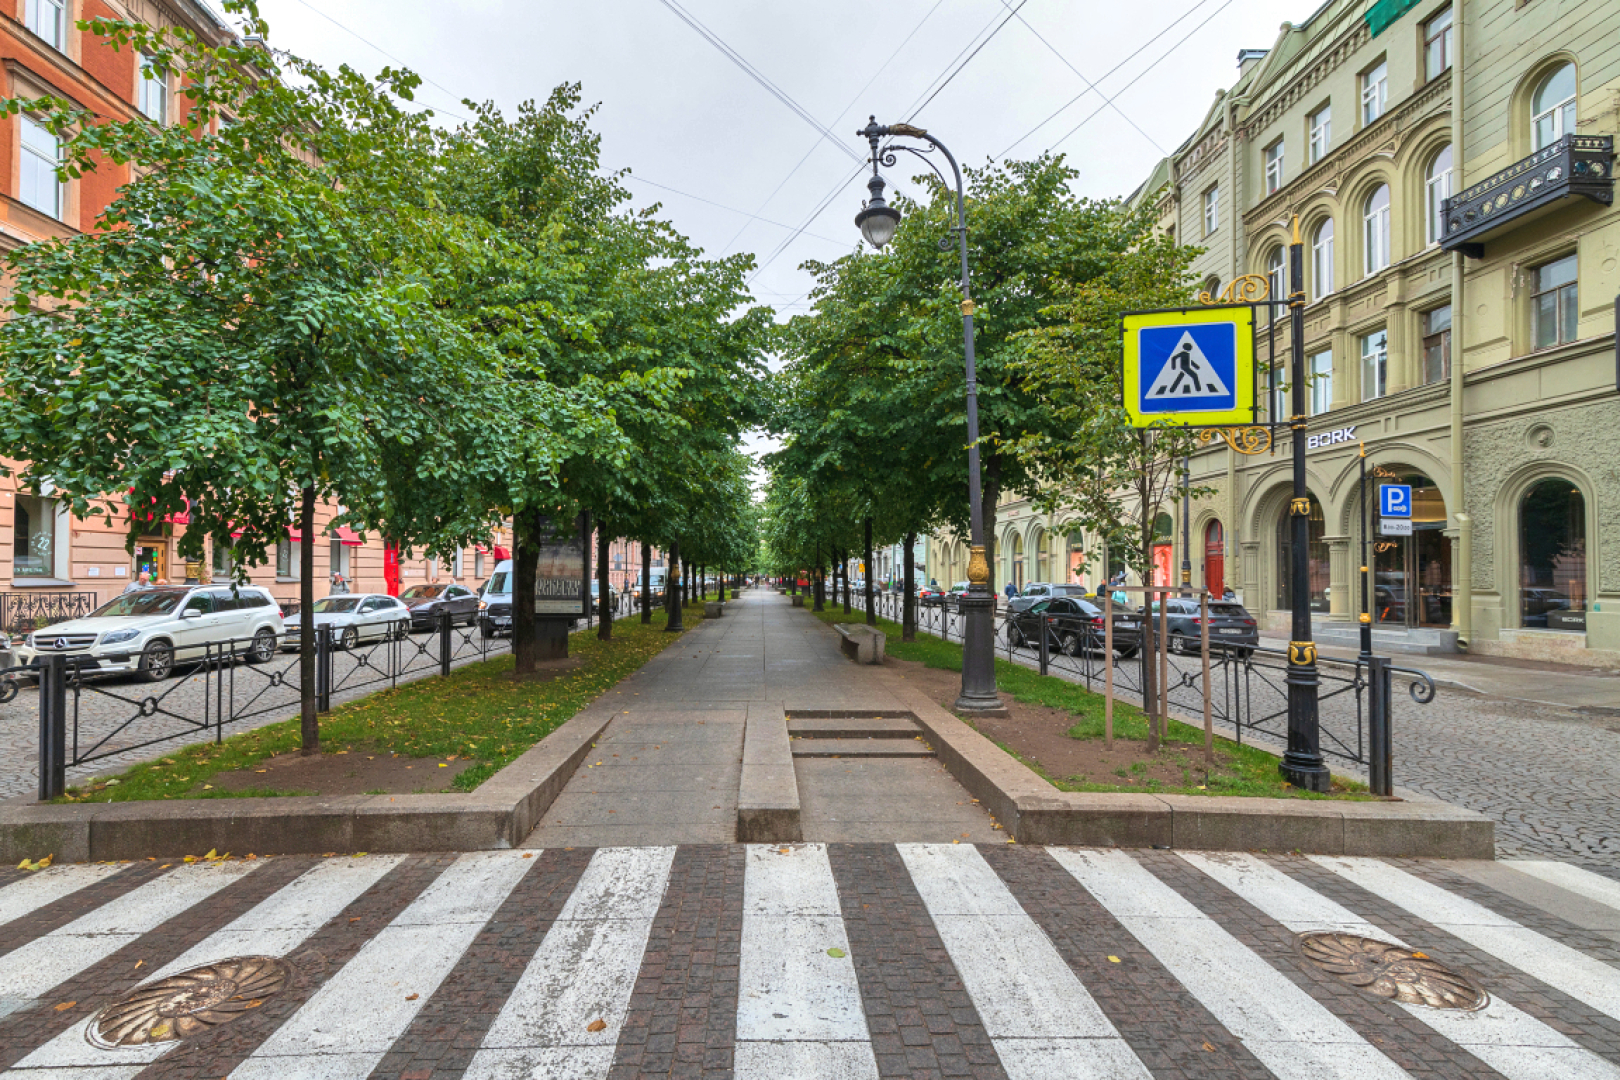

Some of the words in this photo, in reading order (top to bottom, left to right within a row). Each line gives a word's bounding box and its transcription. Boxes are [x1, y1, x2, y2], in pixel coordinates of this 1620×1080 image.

[1307, 425, 1356, 450] BORK
[1387, 487, 1404, 513] P
[1561, 616, 1585, 624] BORK
